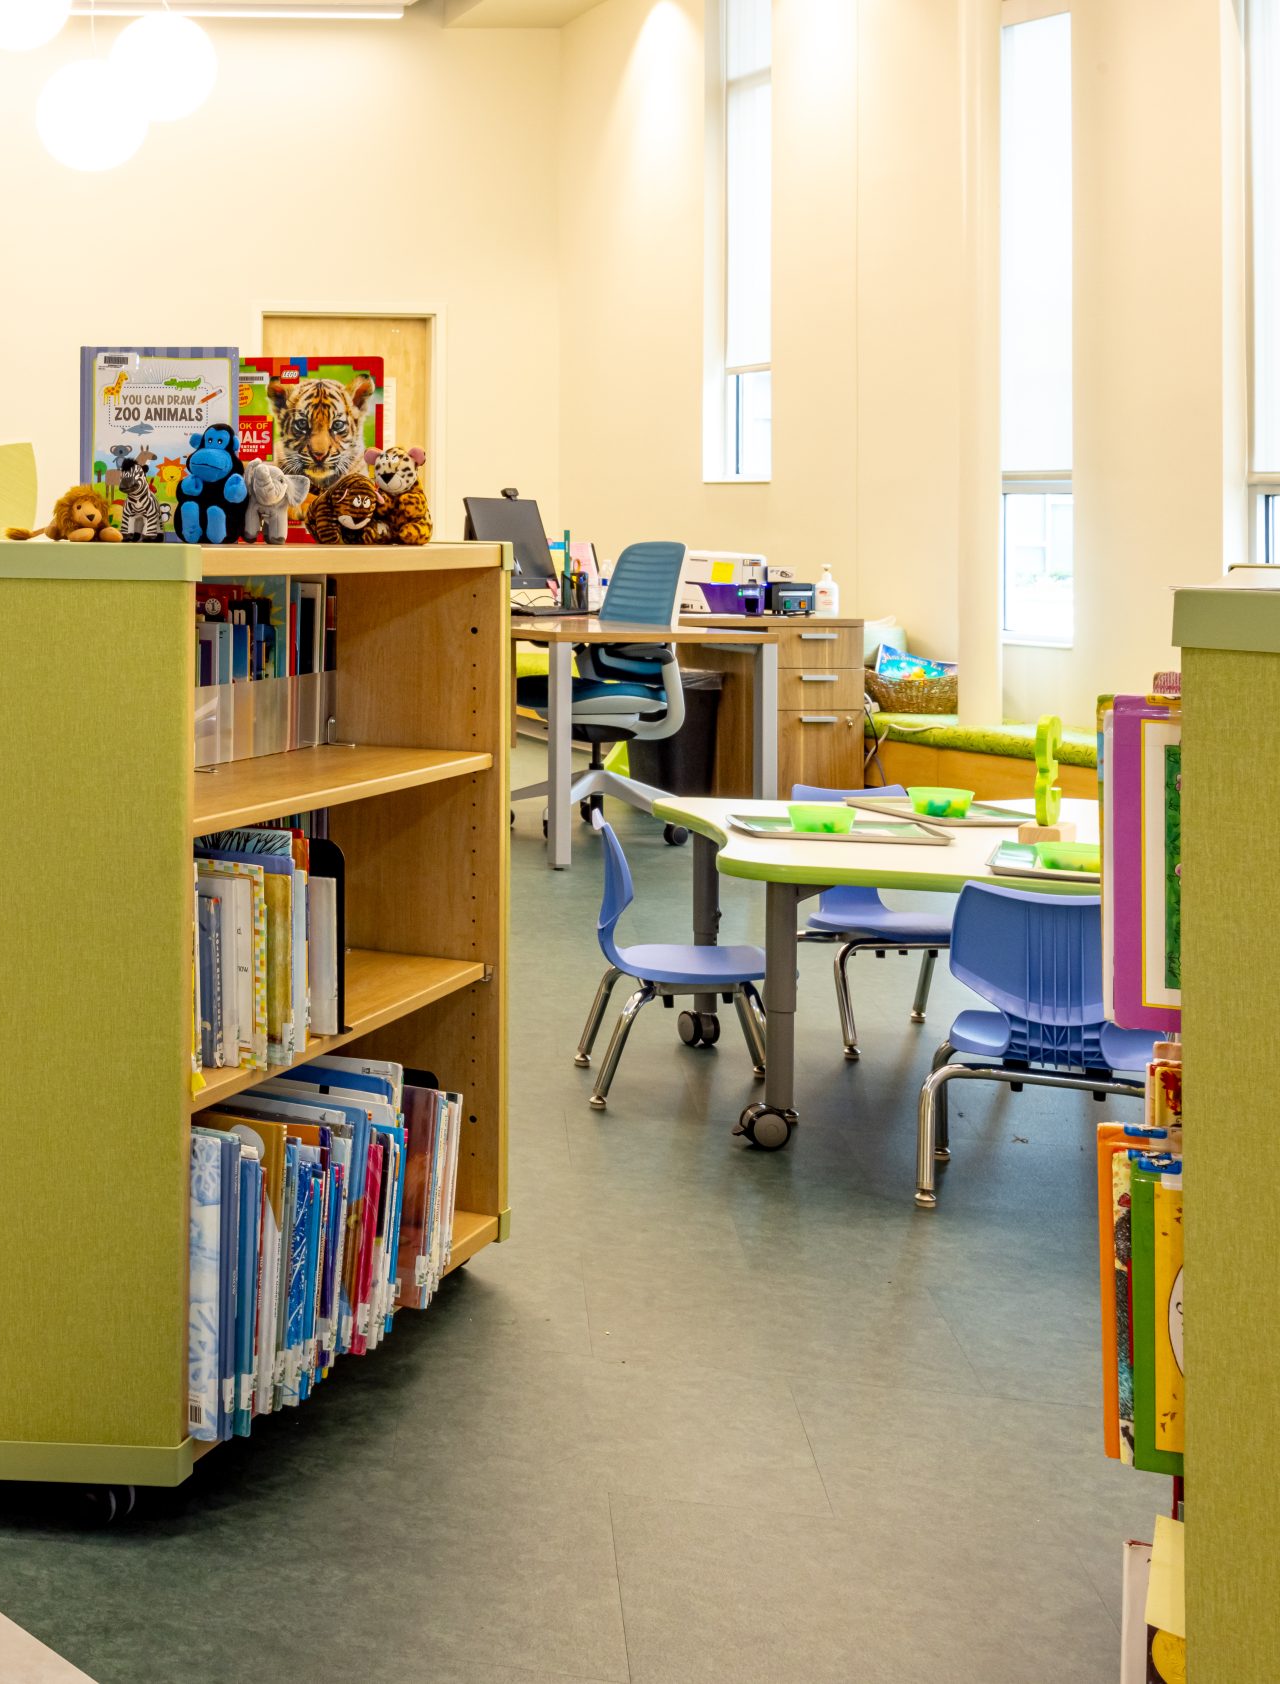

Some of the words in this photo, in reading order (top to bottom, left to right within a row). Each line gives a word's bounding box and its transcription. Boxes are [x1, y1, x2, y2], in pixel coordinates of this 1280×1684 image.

[122, 394, 141, 405] YOU
[144, 394, 165, 405] CAN
[167, 394, 196, 405] DRAW
[114, 407, 141, 421] ZOO
[144, 407, 204, 421] ANIMALS
[239, 422, 252, 430] OK
[256, 422, 269, 430] OF
[238, 430, 271, 444] ALS
